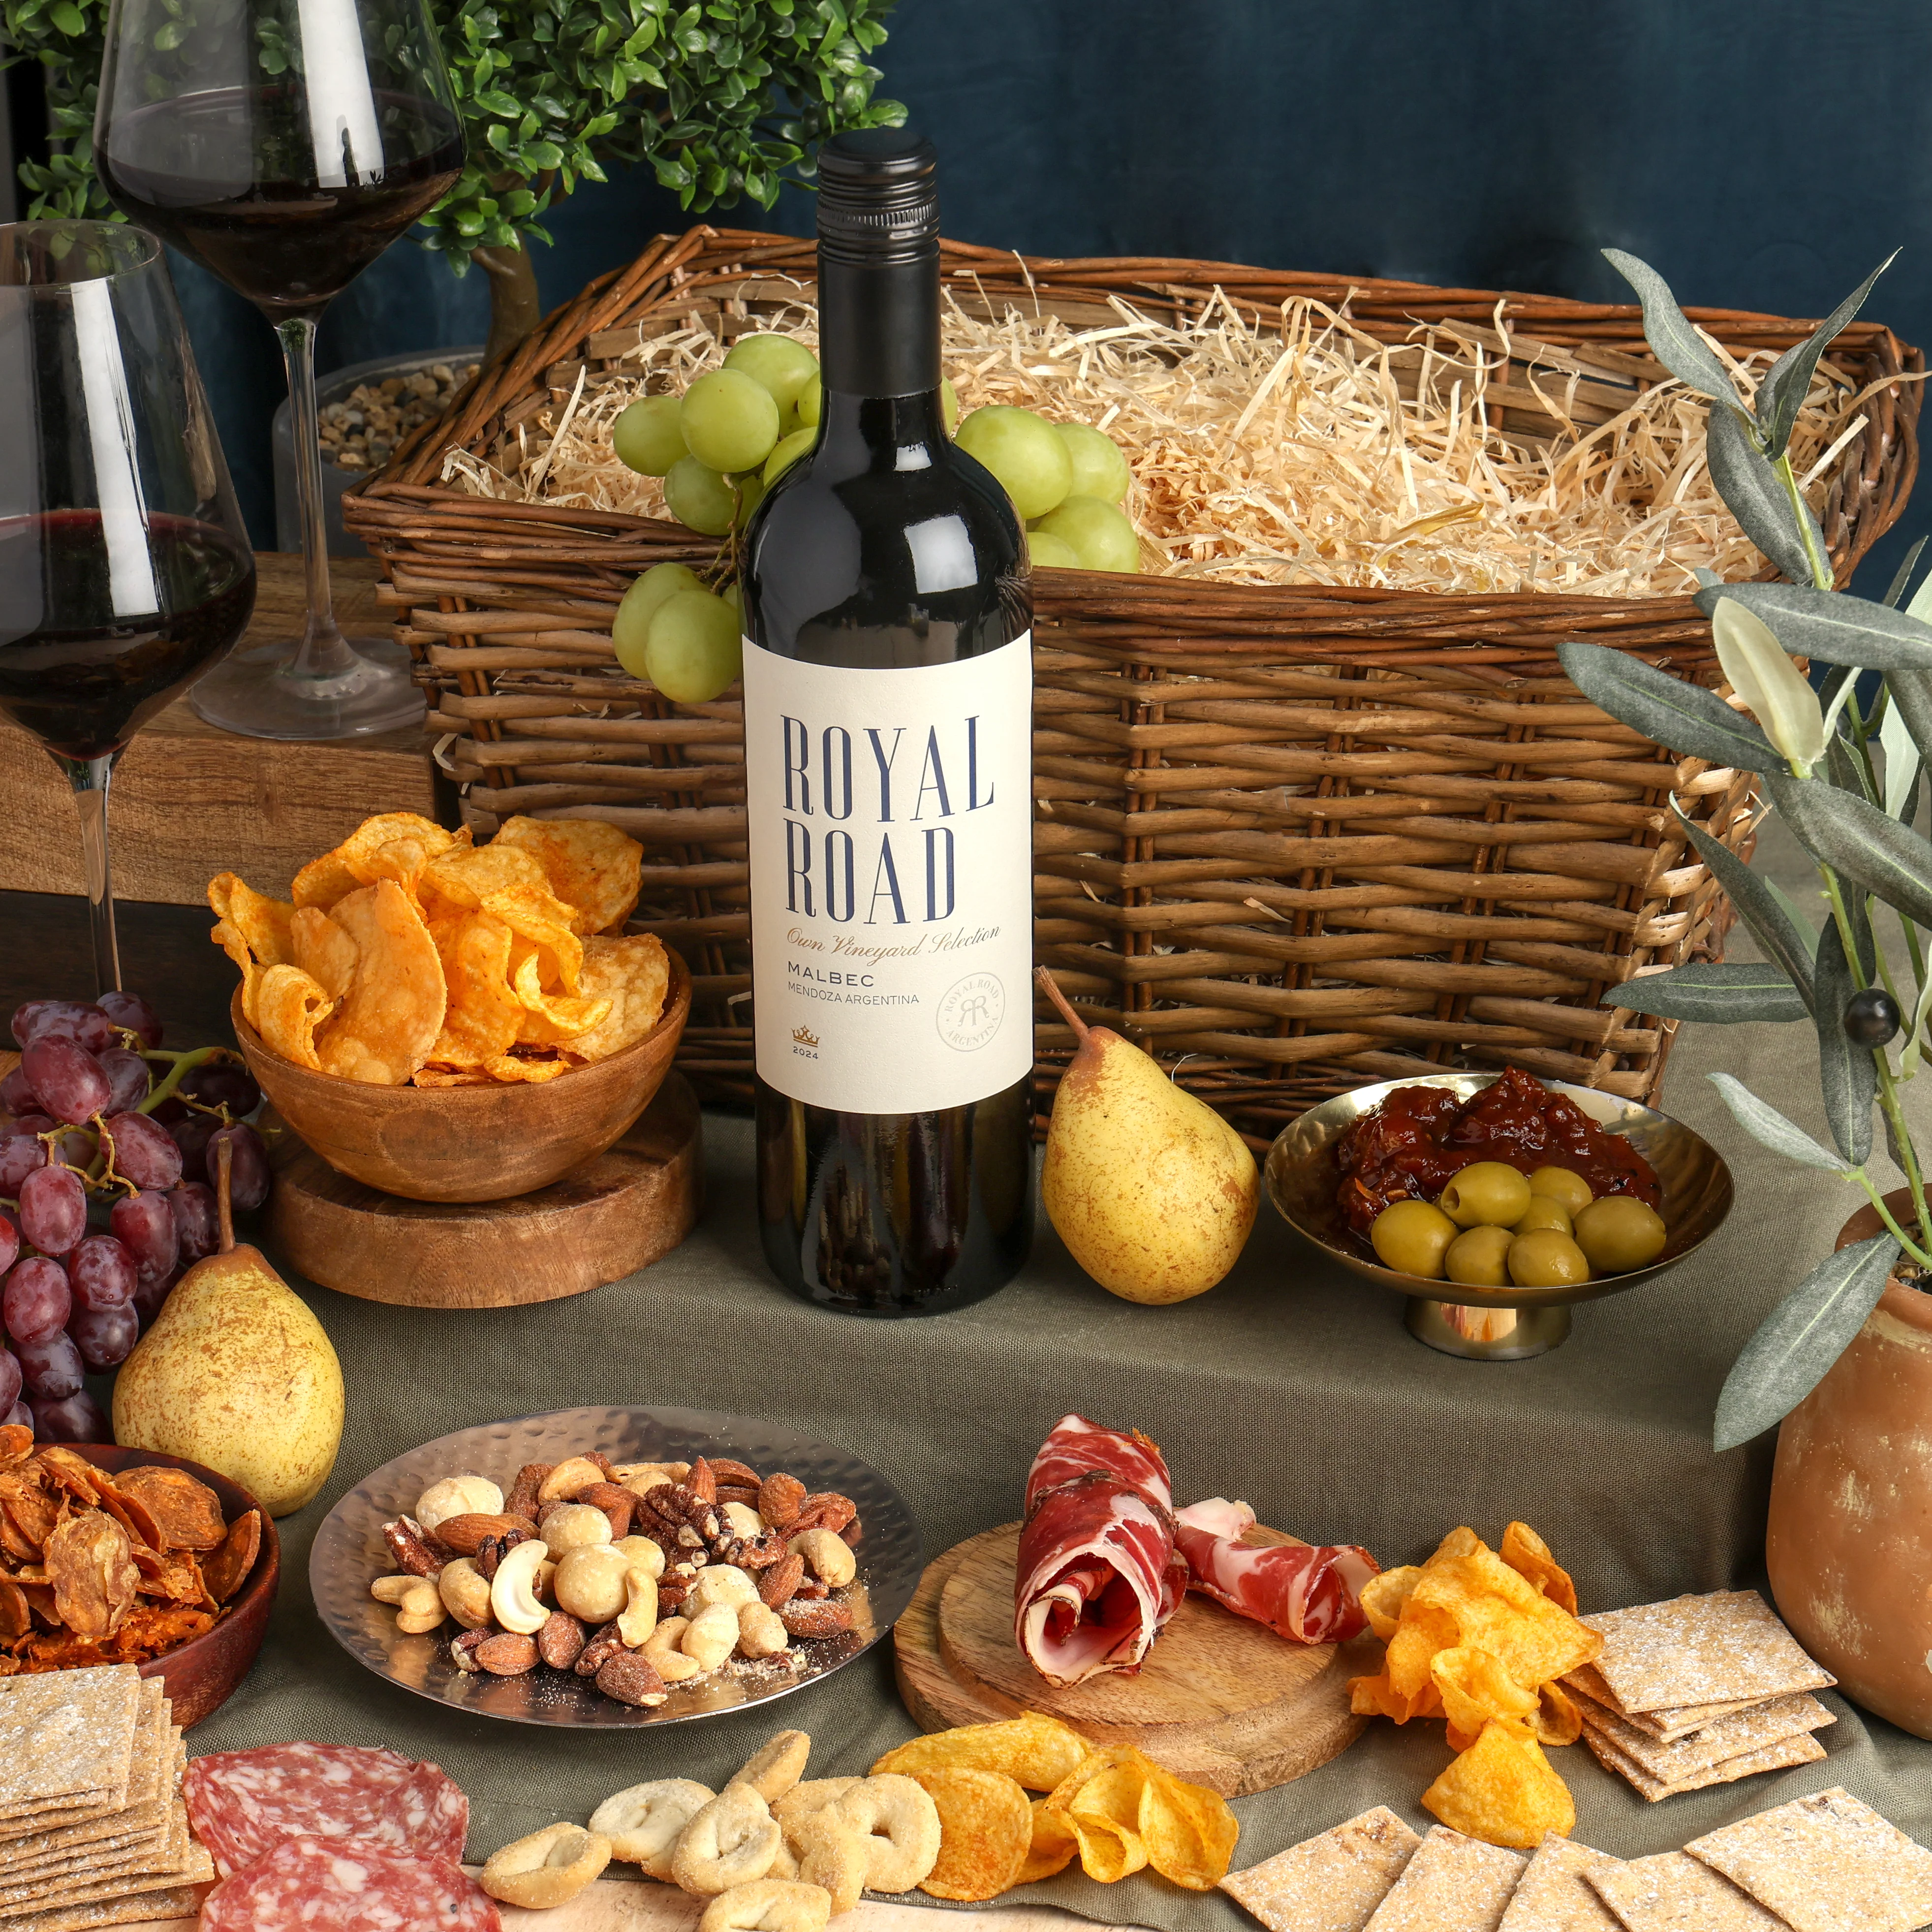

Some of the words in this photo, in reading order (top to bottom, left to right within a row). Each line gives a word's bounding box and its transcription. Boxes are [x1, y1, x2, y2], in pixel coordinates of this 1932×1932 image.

[780, 714, 994, 822] ROYAL
[783, 817, 955, 924] ROAD
[786, 927, 825, 951] Own
[830, 934, 928, 966] Vineyard
[928, 926, 1001, 954] Selection
[787, 961, 874, 988] MALBEC
[788, 981, 842, 1003] MENDOZA
[844, 993, 920, 1006] ARGENTINA
[944, 981, 975, 1012] ROYAL
[977, 979, 999, 999] ROAD
[945, 1017, 999, 1046] ARGENTINA
[792, 1046, 819, 1060] 2024
